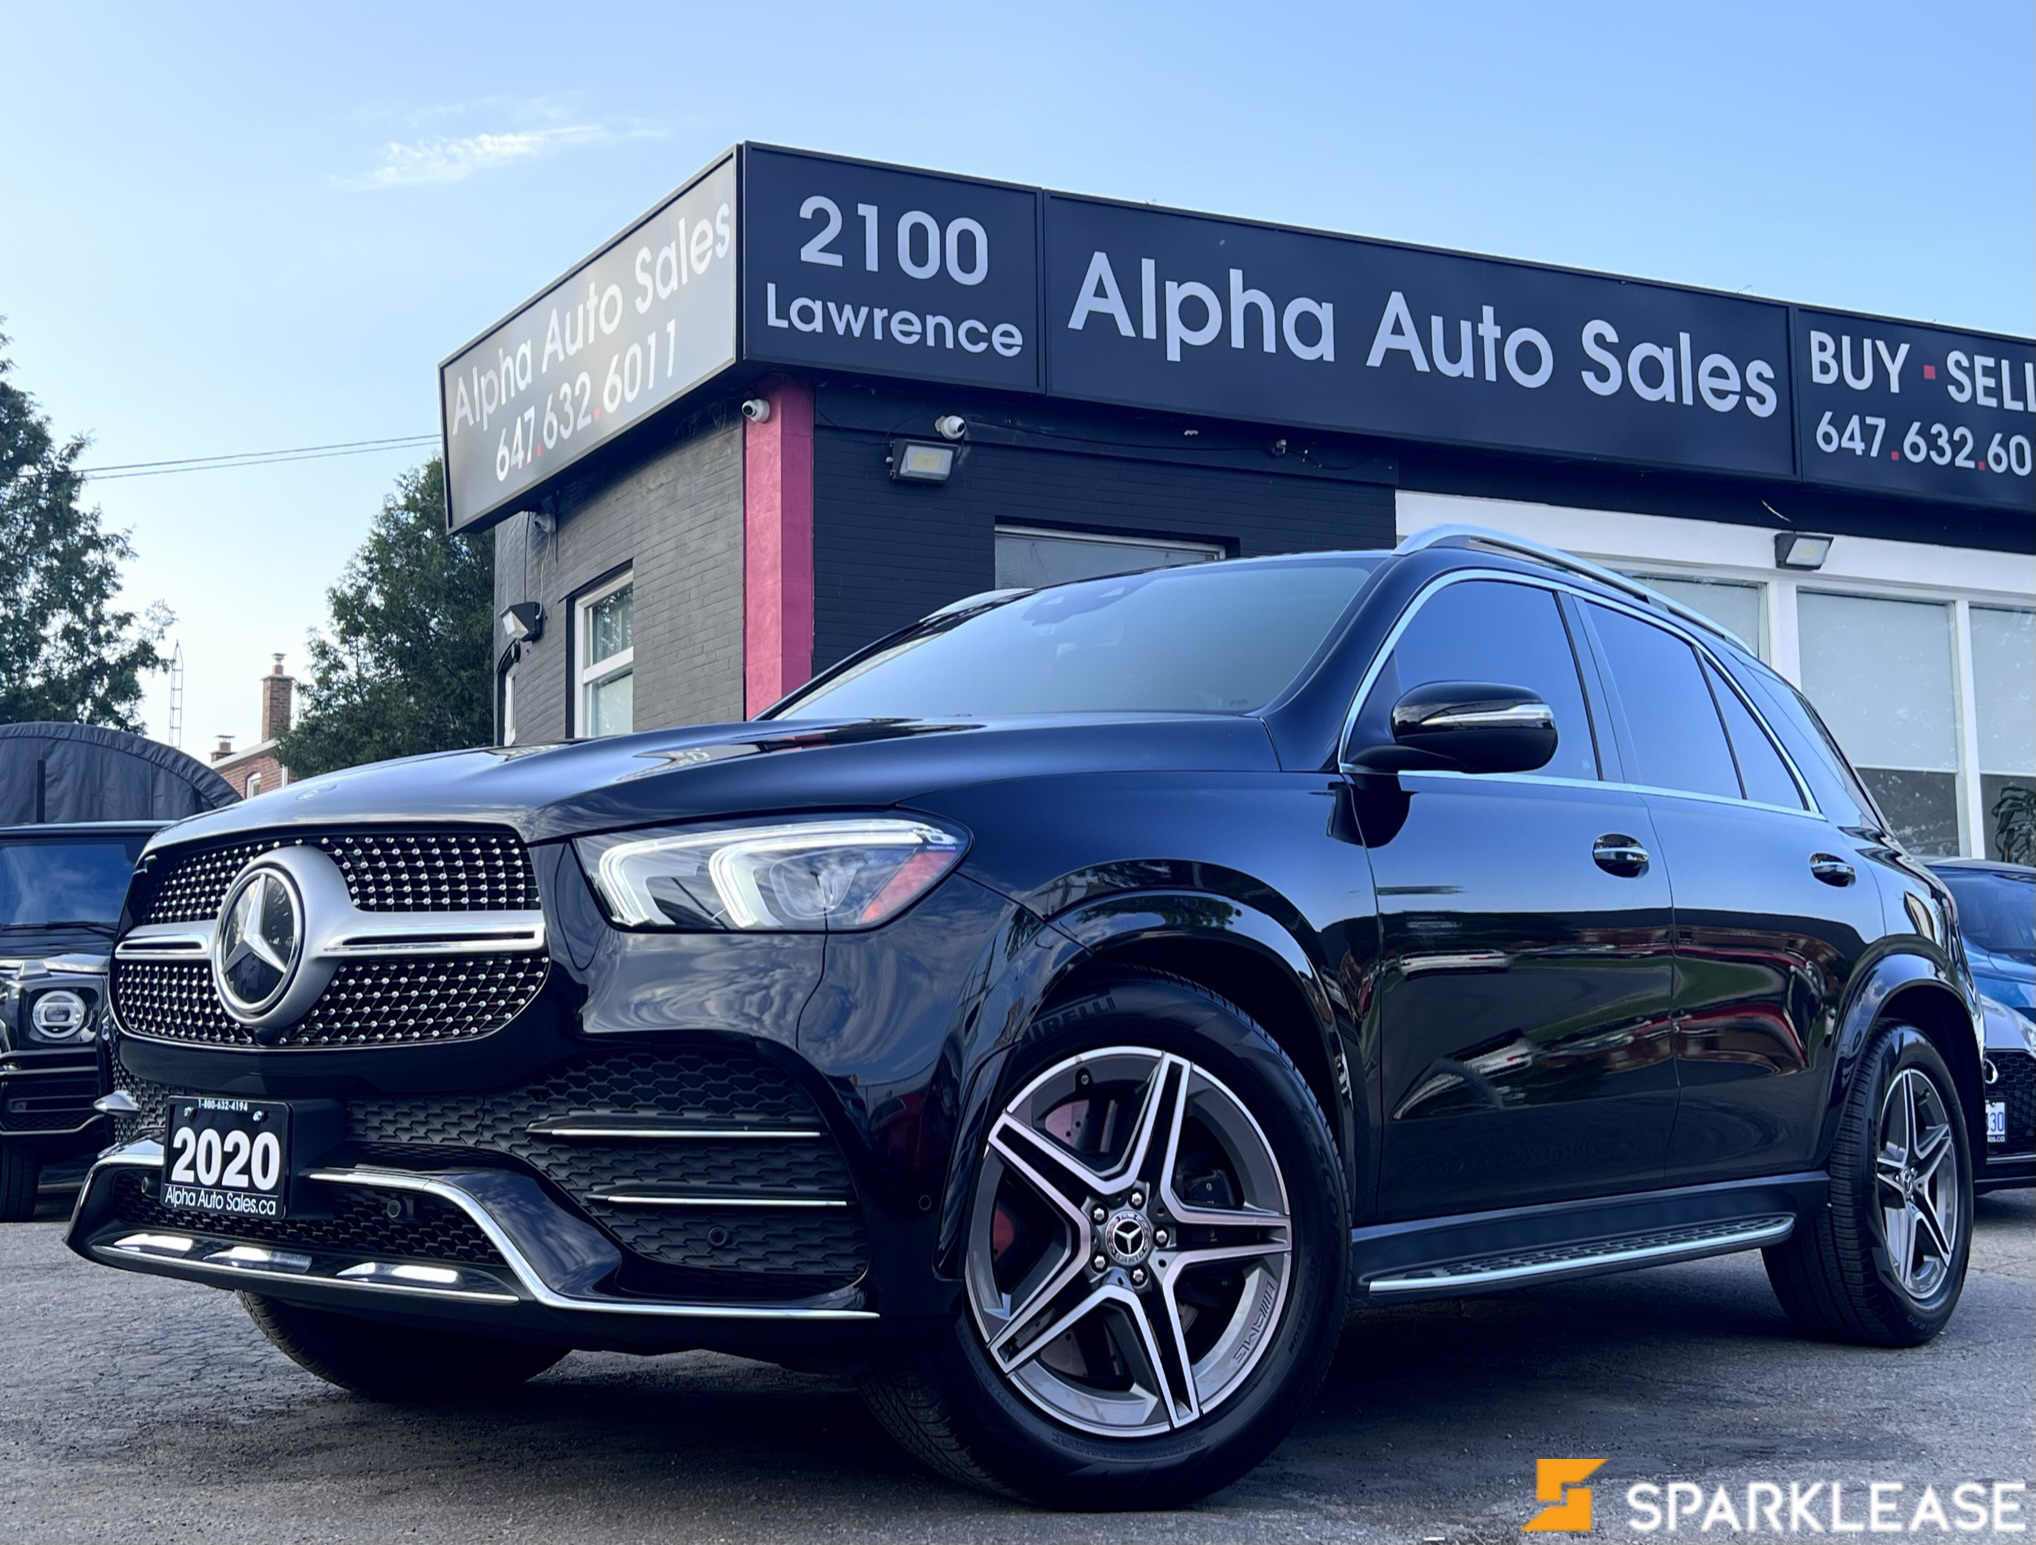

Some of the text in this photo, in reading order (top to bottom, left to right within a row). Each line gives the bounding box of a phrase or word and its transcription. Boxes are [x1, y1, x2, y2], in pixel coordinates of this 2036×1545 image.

[799, 195, 989, 287] 2100
[453, 202, 731, 436] Alpha Auto Sales
[766, 282, 1024, 358] Lawrence
[1067, 251, 1779, 418] Alpha Auto Sales
[495, 318, 677, 482] 647.632.6011
[1810, 330, 1910, 394] BUY
[171, 1126, 280, 1191] 2020
[165, 1186, 276, 1216] Alpha Auto Sales.ca
